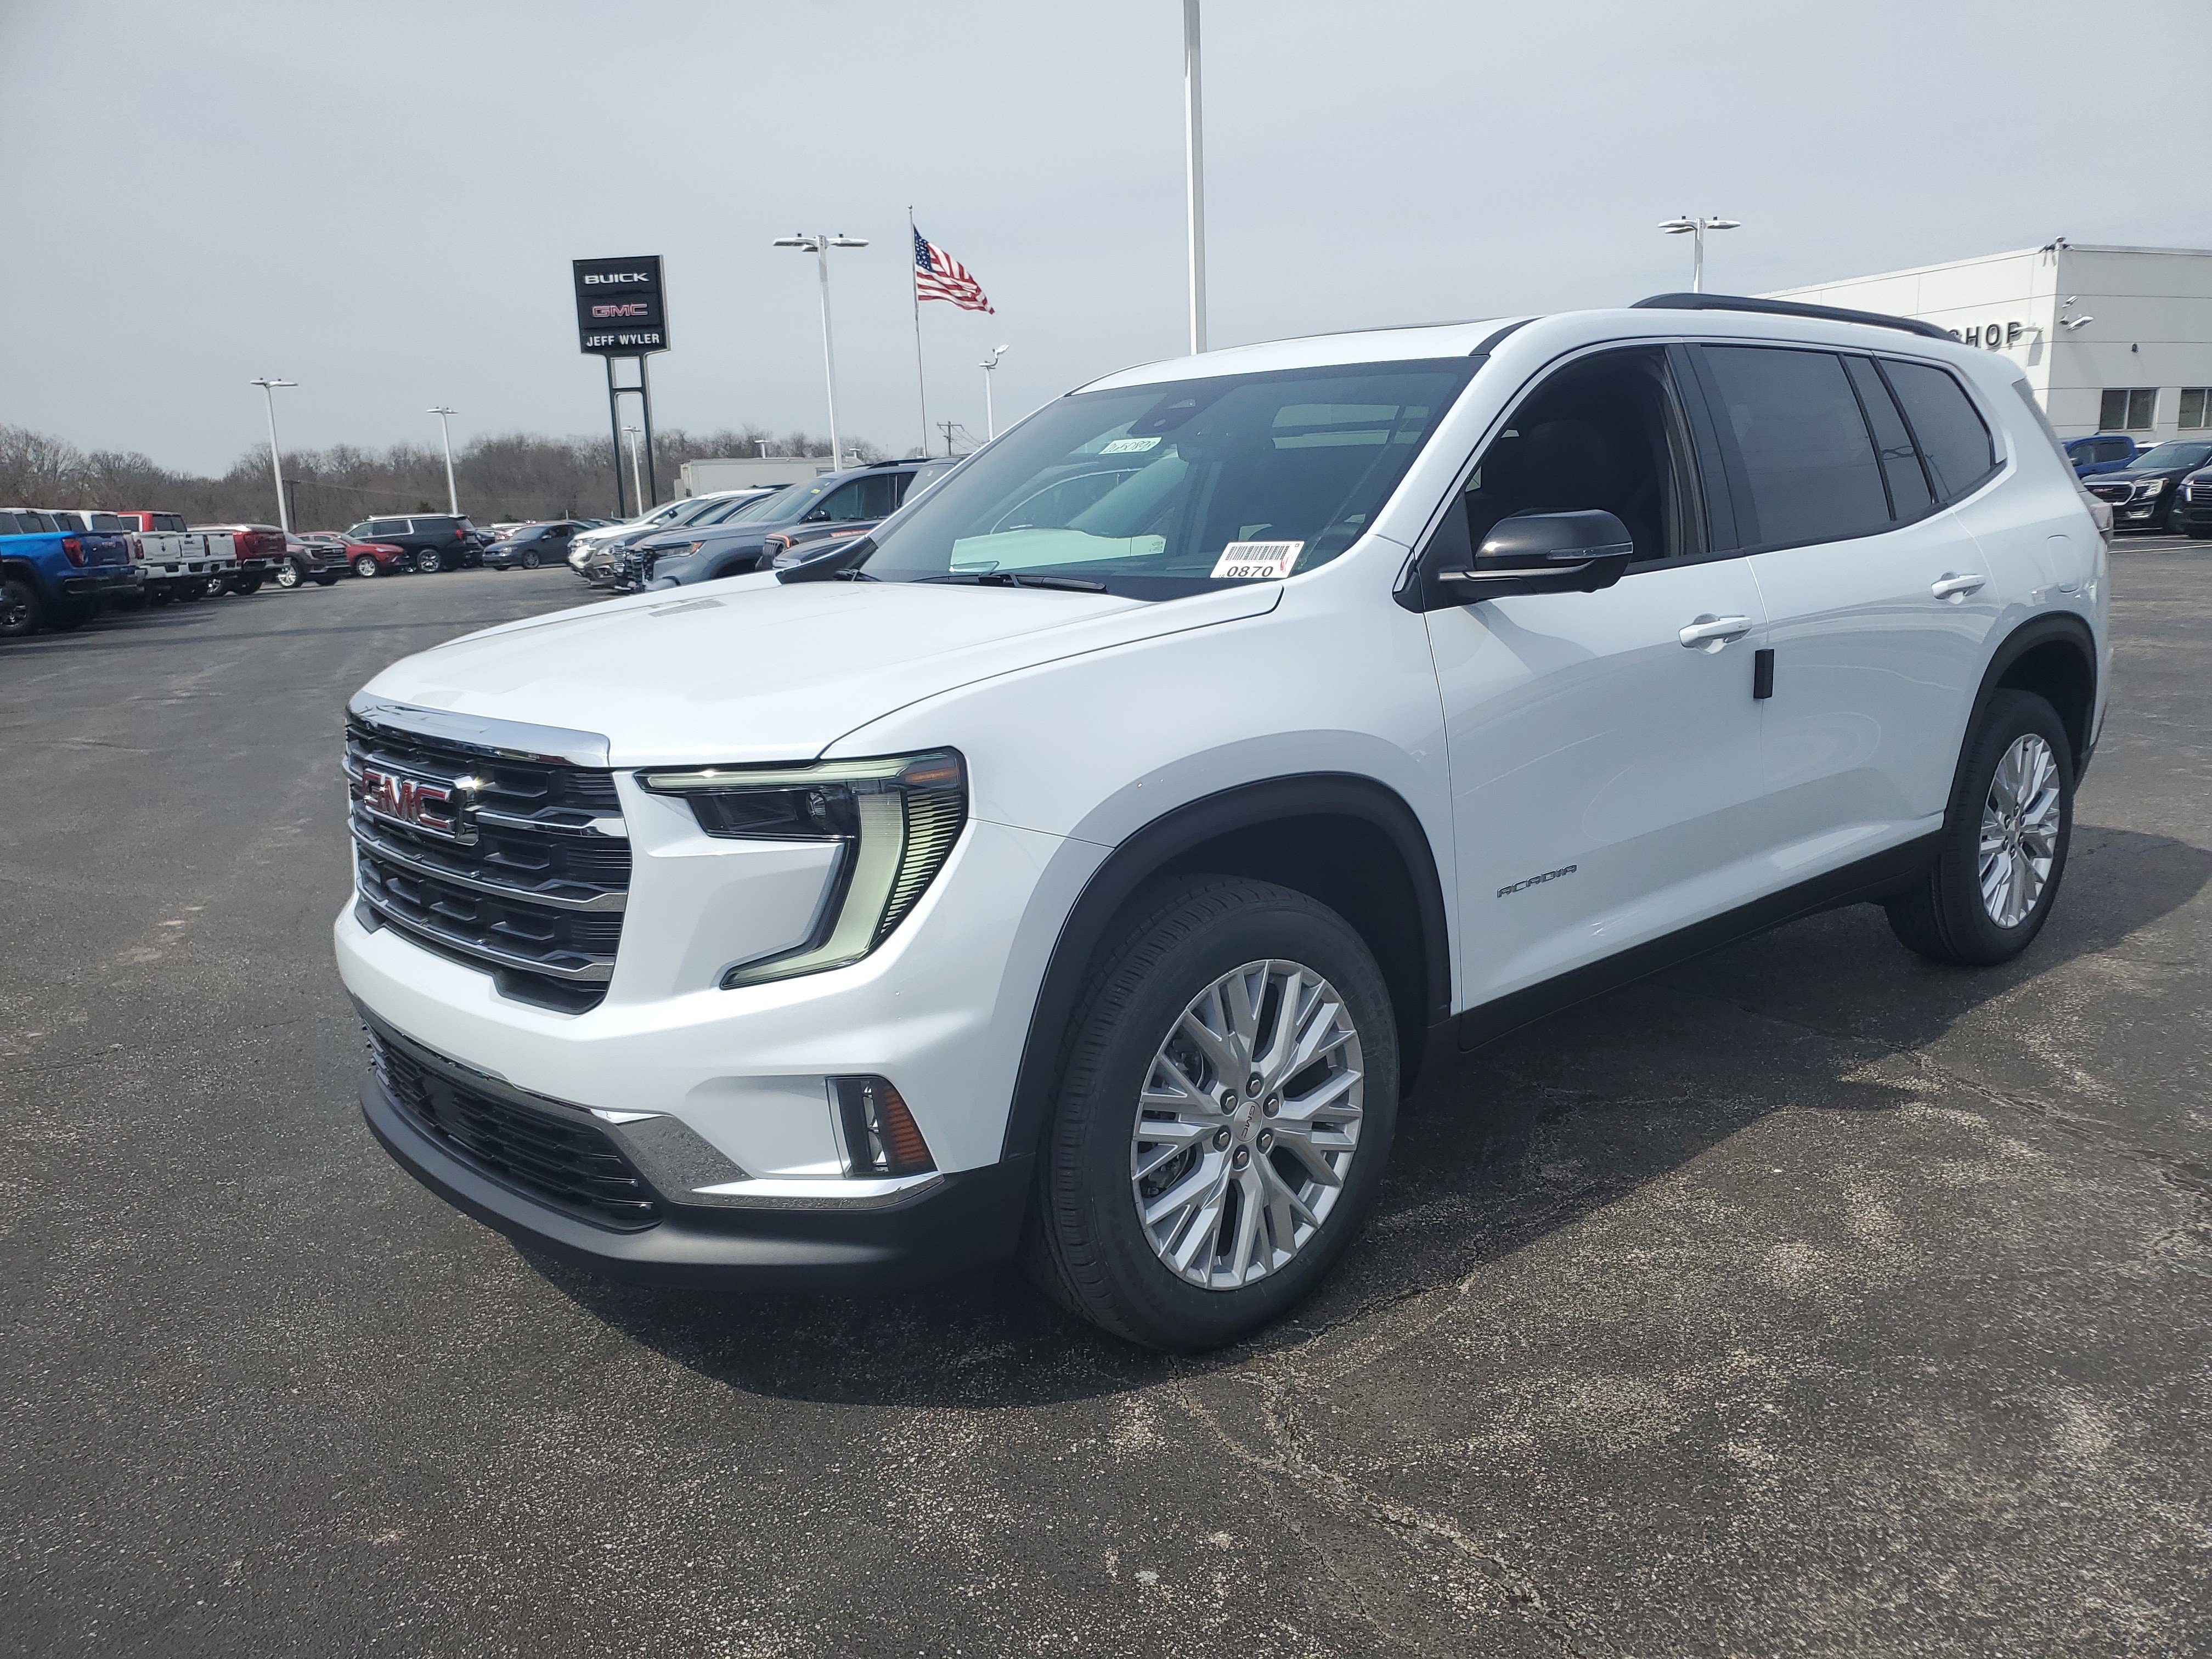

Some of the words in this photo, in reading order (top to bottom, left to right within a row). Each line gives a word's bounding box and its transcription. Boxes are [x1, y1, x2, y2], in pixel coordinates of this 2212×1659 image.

[584, 273, 650, 284] BUICK
[592, 303, 648, 318] GMC
[586, 335, 614, 347] JEFF
[619, 333, 659, 345] WYLER
[1227, 566, 1273, 577] 0870
[362, 768, 456, 833] GMC
[1497, 864, 1577, 898] ACADIA
[1241, 1105, 1255, 1138] GMC
